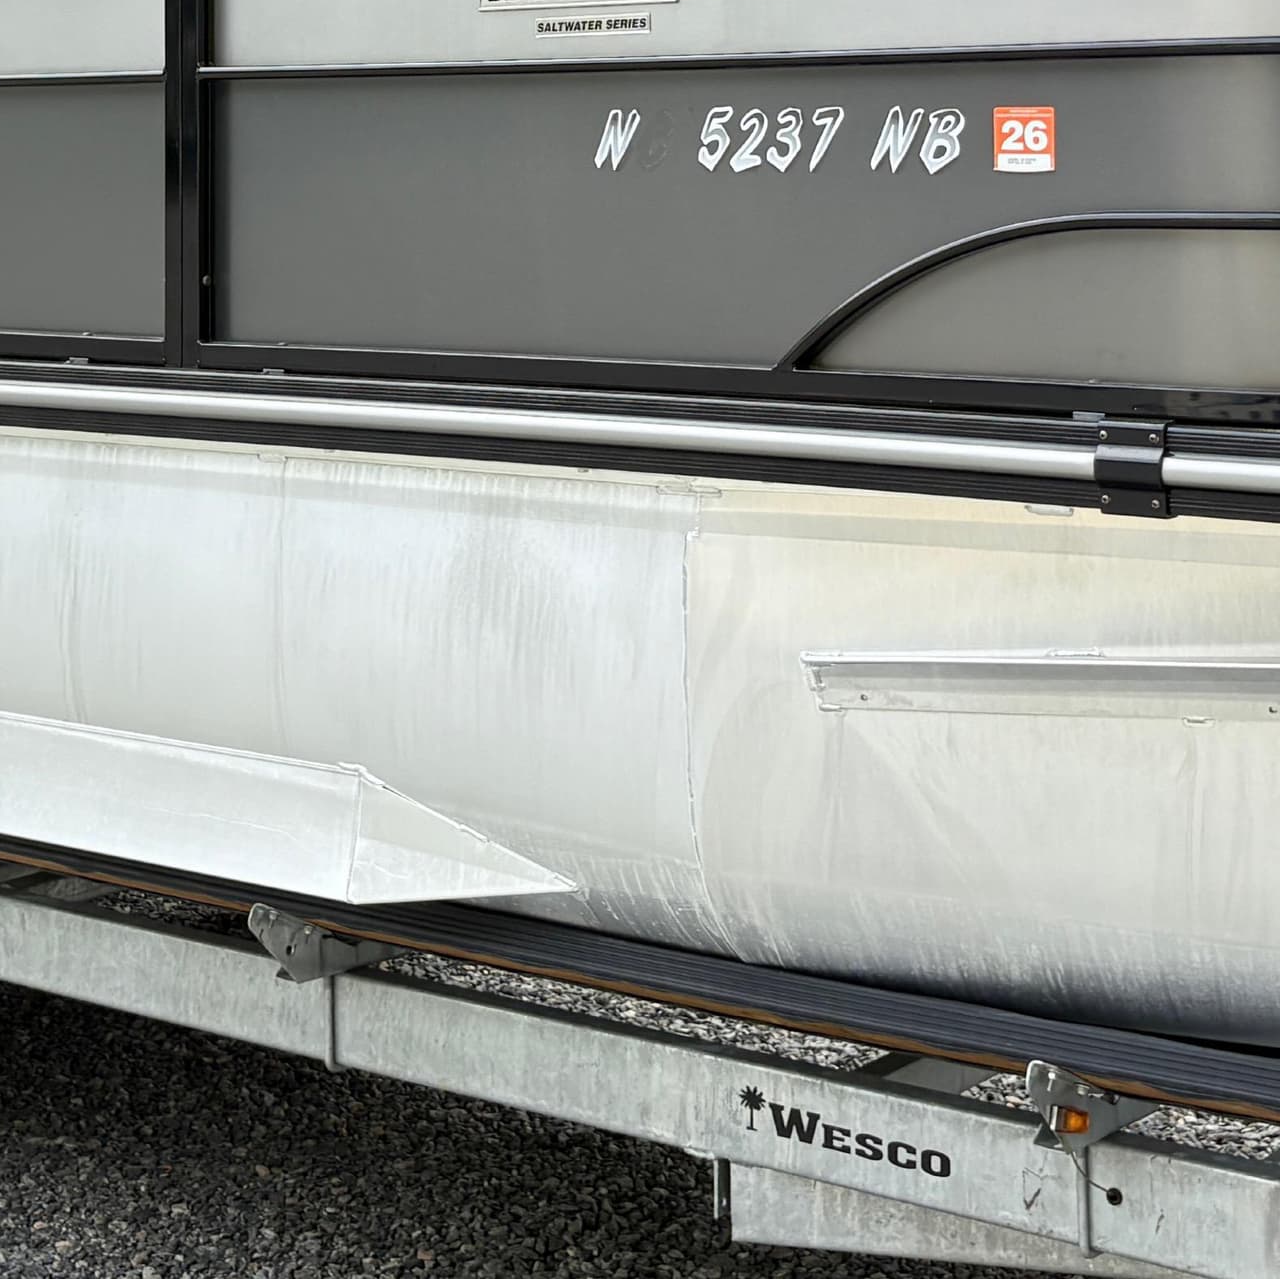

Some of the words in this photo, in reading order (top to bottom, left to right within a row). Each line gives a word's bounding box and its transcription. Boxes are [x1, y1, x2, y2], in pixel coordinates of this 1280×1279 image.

[536, 19, 603, 33] SALTWATER
[605, 17, 648, 31] SERIES
[697, 105, 845, 174] 5237
[869, 104, 966, 176] NB
[1000, 119, 1048, 152] 26
